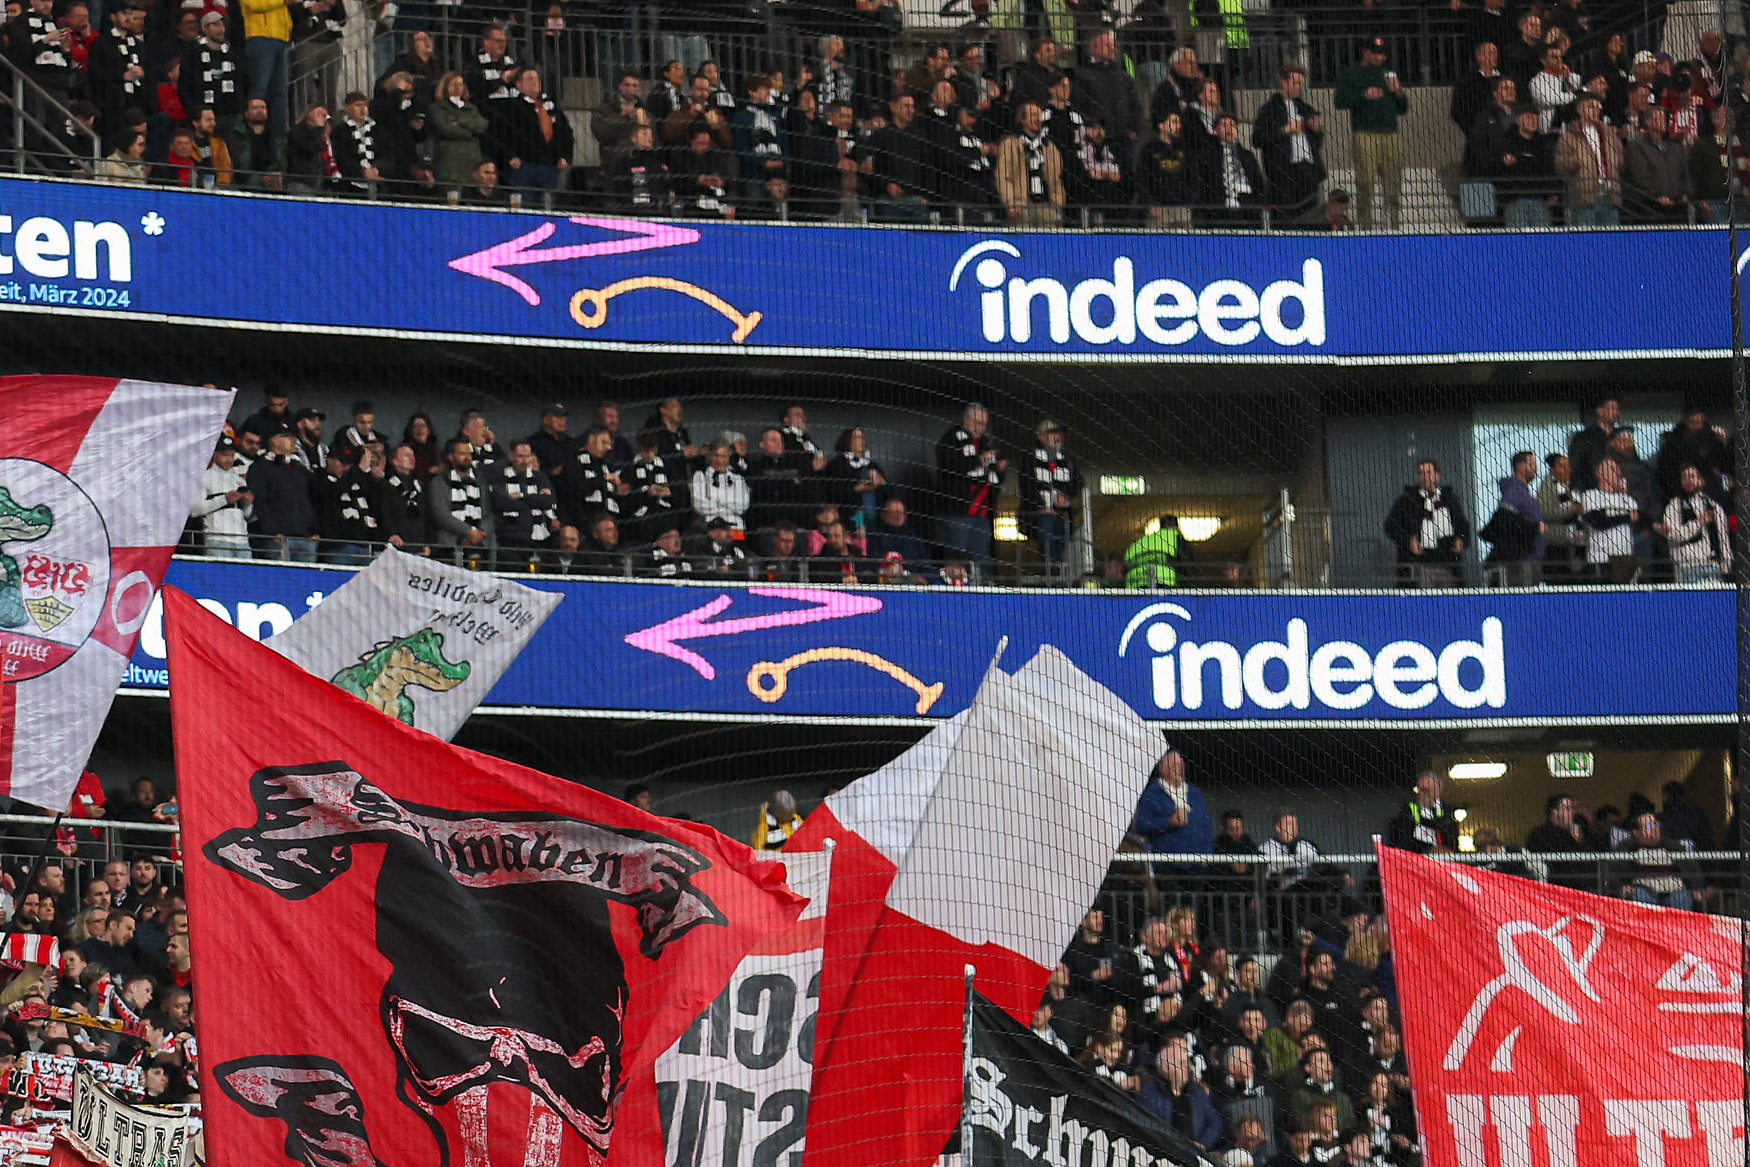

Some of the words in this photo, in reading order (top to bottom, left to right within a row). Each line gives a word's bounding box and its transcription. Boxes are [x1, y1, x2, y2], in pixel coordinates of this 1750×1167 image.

[30, 284, 78, 306] März
[82, 287, 131, 308] 2024
[950, 241, 1327, 346] indeed
[1120, 603, 1508, 709] indeed
